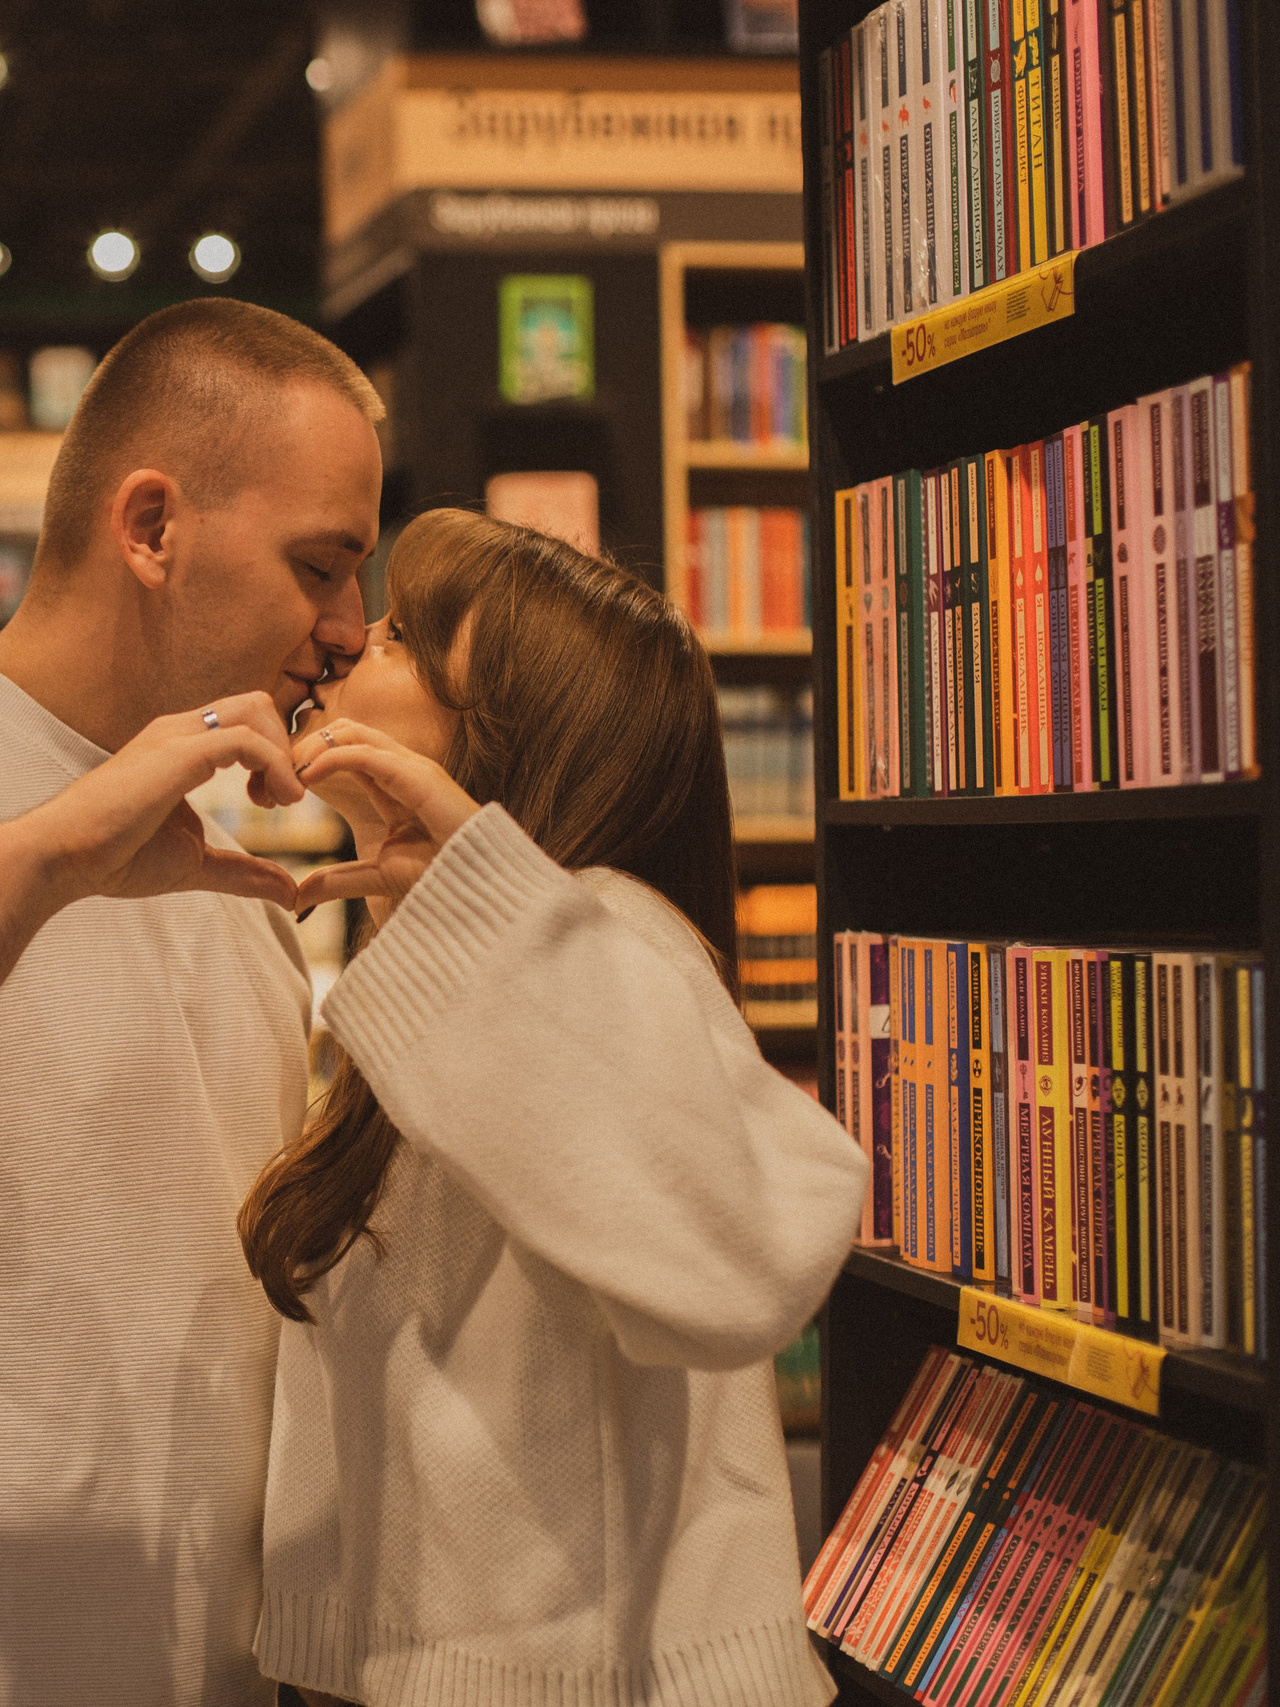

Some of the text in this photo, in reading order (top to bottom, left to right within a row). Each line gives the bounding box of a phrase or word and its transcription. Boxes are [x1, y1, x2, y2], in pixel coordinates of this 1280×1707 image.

[1116, 20, 1125, 80] ЗАПИСКИ
[1134, 4, 1143, 71] СОБАКА
[993, 95, 1001, 154] ПОВЕСТЬ
[1018, 86, 1027, 185] ФИНАНСИСТ
[1031, 76, 1043, 170] ТИТАН
[1053, 61, 1062, 129] «ГЕНИЙ»
[1074, 52, 1086, 192] ПОВОРОТ ВИНТА
[1119, 98, 1127, 160] ШЕРЛОКЕ
[883, 150, 891, 263] ОТВЕРЖЕННЫЕ
[901, 140, 909, 258] ОТВЕРЖЕННЫЕ
[925, 128, 934, 246] ОТВЕРЖЕННЫЕ
[952, 176, 960, 231] КОТОРЫЙ
[970, 106, 983, 269] ЛАВКА ДРЕВНОСТЕЙ
[994, 173, 1002, 208] ДВУХ
[995, 212, 1004, 272] ГОРОДАХ
[901, 323, 936, 366] -50%
[1055, 444, 1063, 502] ВАШИНГТОН
[946, 615, 954, 673] ДОКТОР
[973, 607, 981, 684] ЗАПАДНЯ
[992, 605, 1000, 693] КНИЖНЫЙ
[1087, 588, 1096, 666] ПРОЦЕСС
[1096, 583, 1106, 634] ЦВЕТА
[931, 617, 939, 691] ДАМСКОЕ
[1018, 634, 1028, 735] ПОСЛАННИК
[1037, 630, 1046, 731] ПОСЛАННИК
[1050, 594, 1060, 744] СОННАЯ ЛОЩИНА
[1059, 594, 1069, 744] СОННАЯ ЛОЩИНА
[1071, 610, 1081, 709] ОТПУСКАЙ
[1098, 664, 1108, 712] ГОДЫ
[1073, 714, 1082, 763] МЕНЯ
[972, 960, 980, 1011] ДЭНИЕЛ
[1039, 964, 1049, 1062] УИЛКИ КОЛЛИНЗ
[973, 1095, 984, 1253] ПРИКОСНОВЕНИЕ
[1020, 1108, 1033, 1269] МЕРТВАЯ КОМНАТА
[1078, 1112, 1086, 1184] ПУТЕШЕСТВИЕ
[1092, 1115, 1103, 1257] ПРИЗРАК ОПЕРЫ
[1115, 1120, 1125, 1180] МОНАХ
[1139, 1123, 1148, 1183] МОНАХ
[927, 1168, 935, 1258] ЭЛДЖЕРНОНА
[1041, 1113, 1056, 1290] ЛУННЫЙ КАМЕНЬ
[1079, 1186, 1087, 1223] ВОКРУГ
[1081, 1261, 1089, 1300] ЧЕРЕПА
[969, 1300, 1009, 1350] -50%
[865, 1485, 917, 1575] МИЛЫЙ ДРУГ
[877, 1480, 906, 1527] ГОЛЕМ
[884, 1515, 973, 1670] ХРОНИКИ ЗАВОДНОЙ ПТИЦЫ
[904, 1525, 993, 1684] ХРОНИКИ ЗАВОДНОЙ ПТИЦЫ
[952, 1537, 1020, 1653] ОХОТА НА ОВЕЦ
[954, 1531, 1007, 1620] АМСТЕРДАМ
[970, 1543, 1038, 1660] ОХОТА НА ОВЕЦ
[985, 1553, 1052, 1671] ОХОТА НА ОВЕЦ
[1003, 1559, 1071, 1680] ОХОТА НА ОВЕЦ
